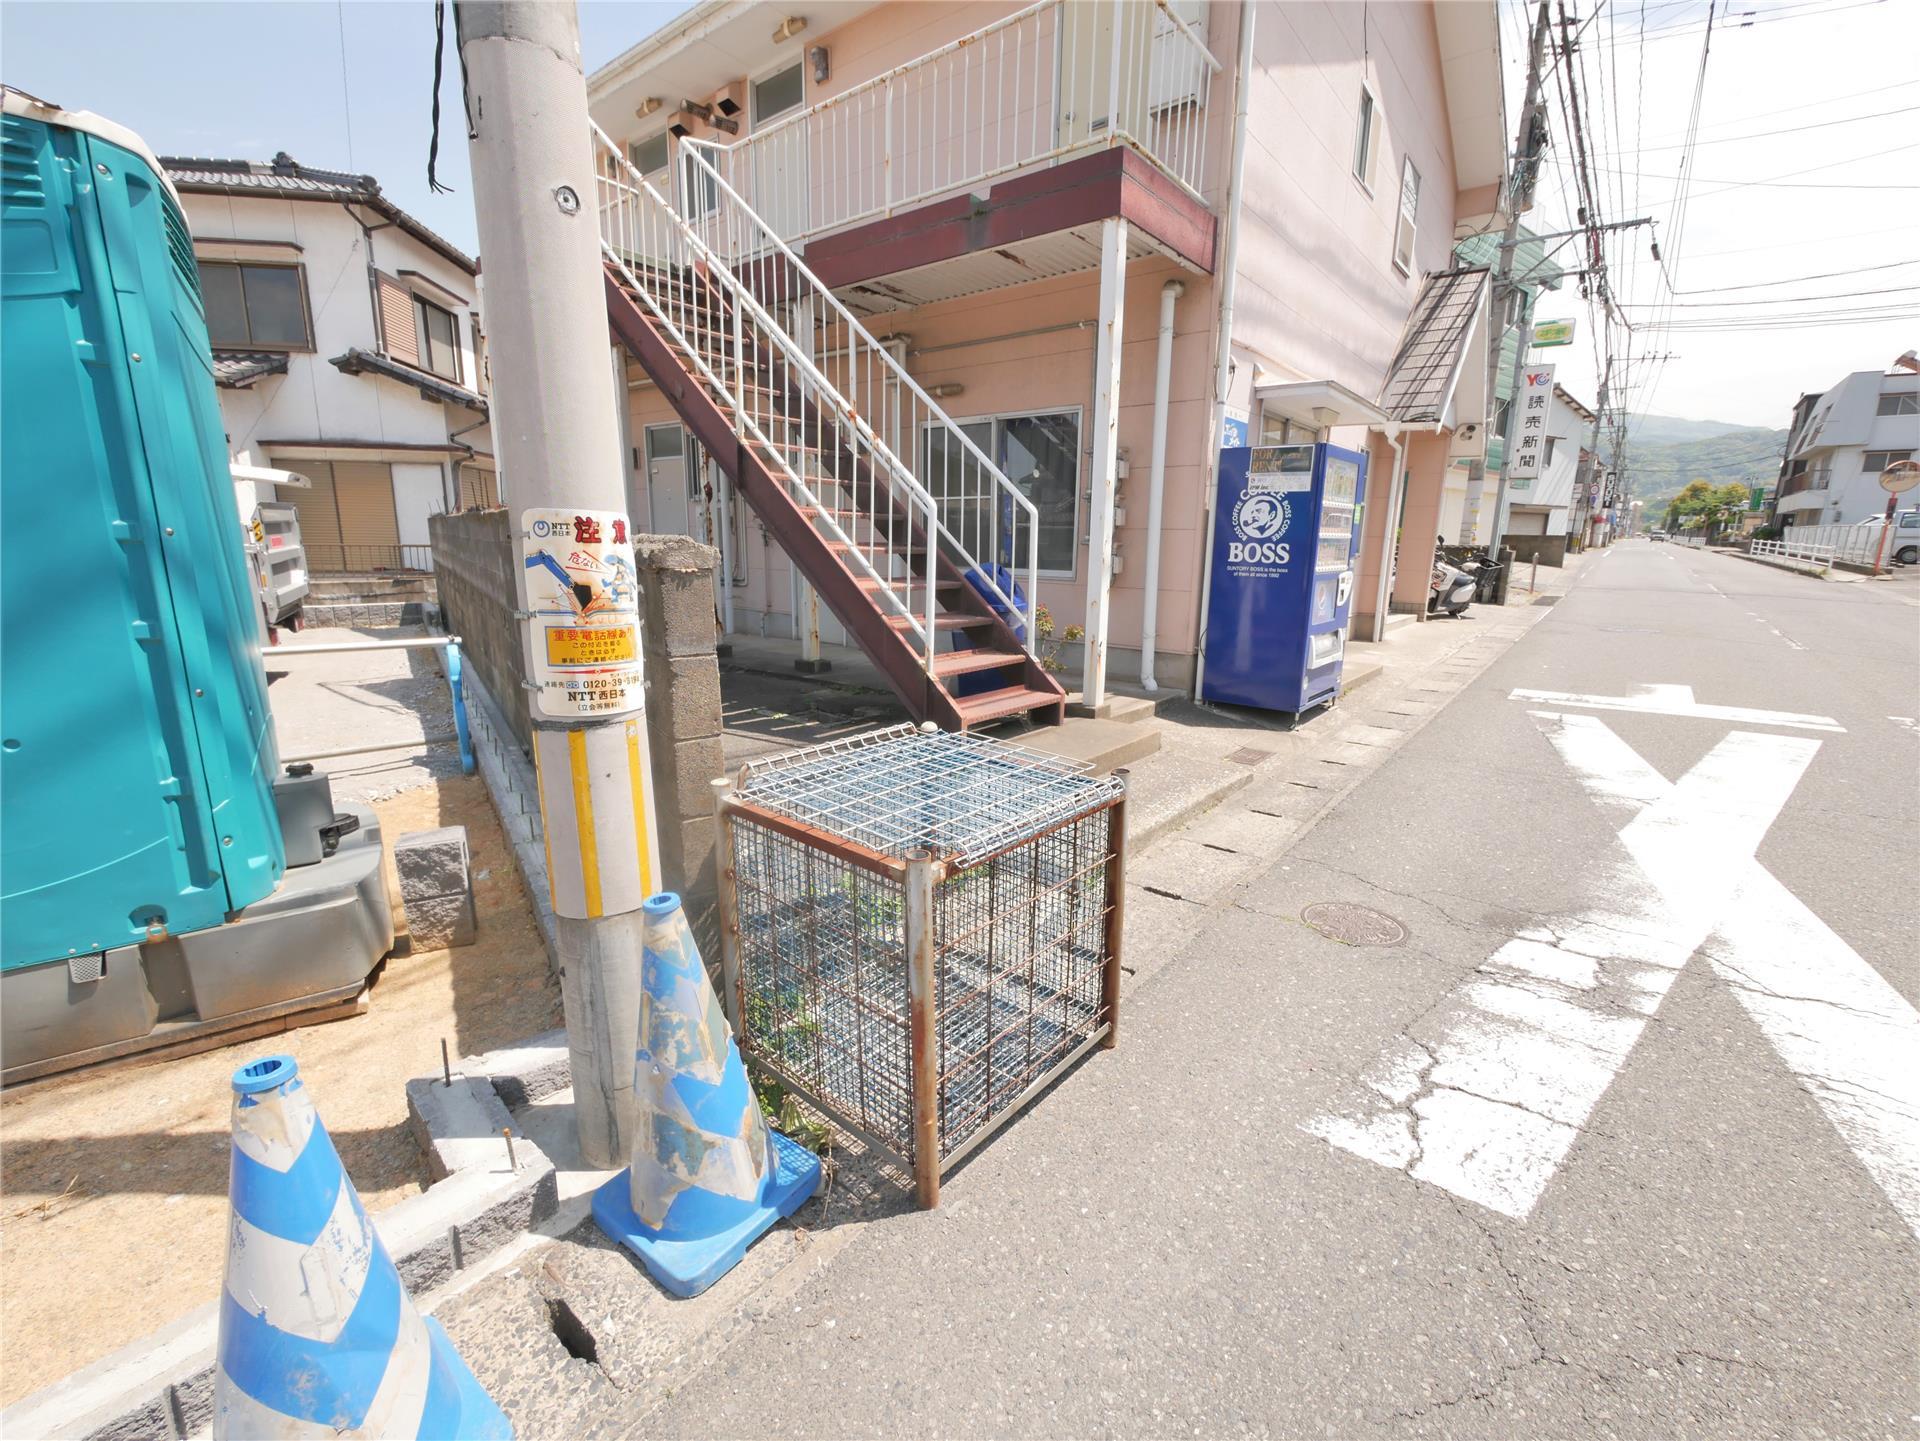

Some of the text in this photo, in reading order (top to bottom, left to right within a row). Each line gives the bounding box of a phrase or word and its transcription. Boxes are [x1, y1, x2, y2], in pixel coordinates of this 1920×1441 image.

[1519, 395, 1545, 468] 読売新聞
[552, 522, 571, 531] NTT
[568, 551, 599, 569] 危ない
[1227, 542, 1290, 564] BOSS
[553, 627, 631, 641] 重要電話線あり
